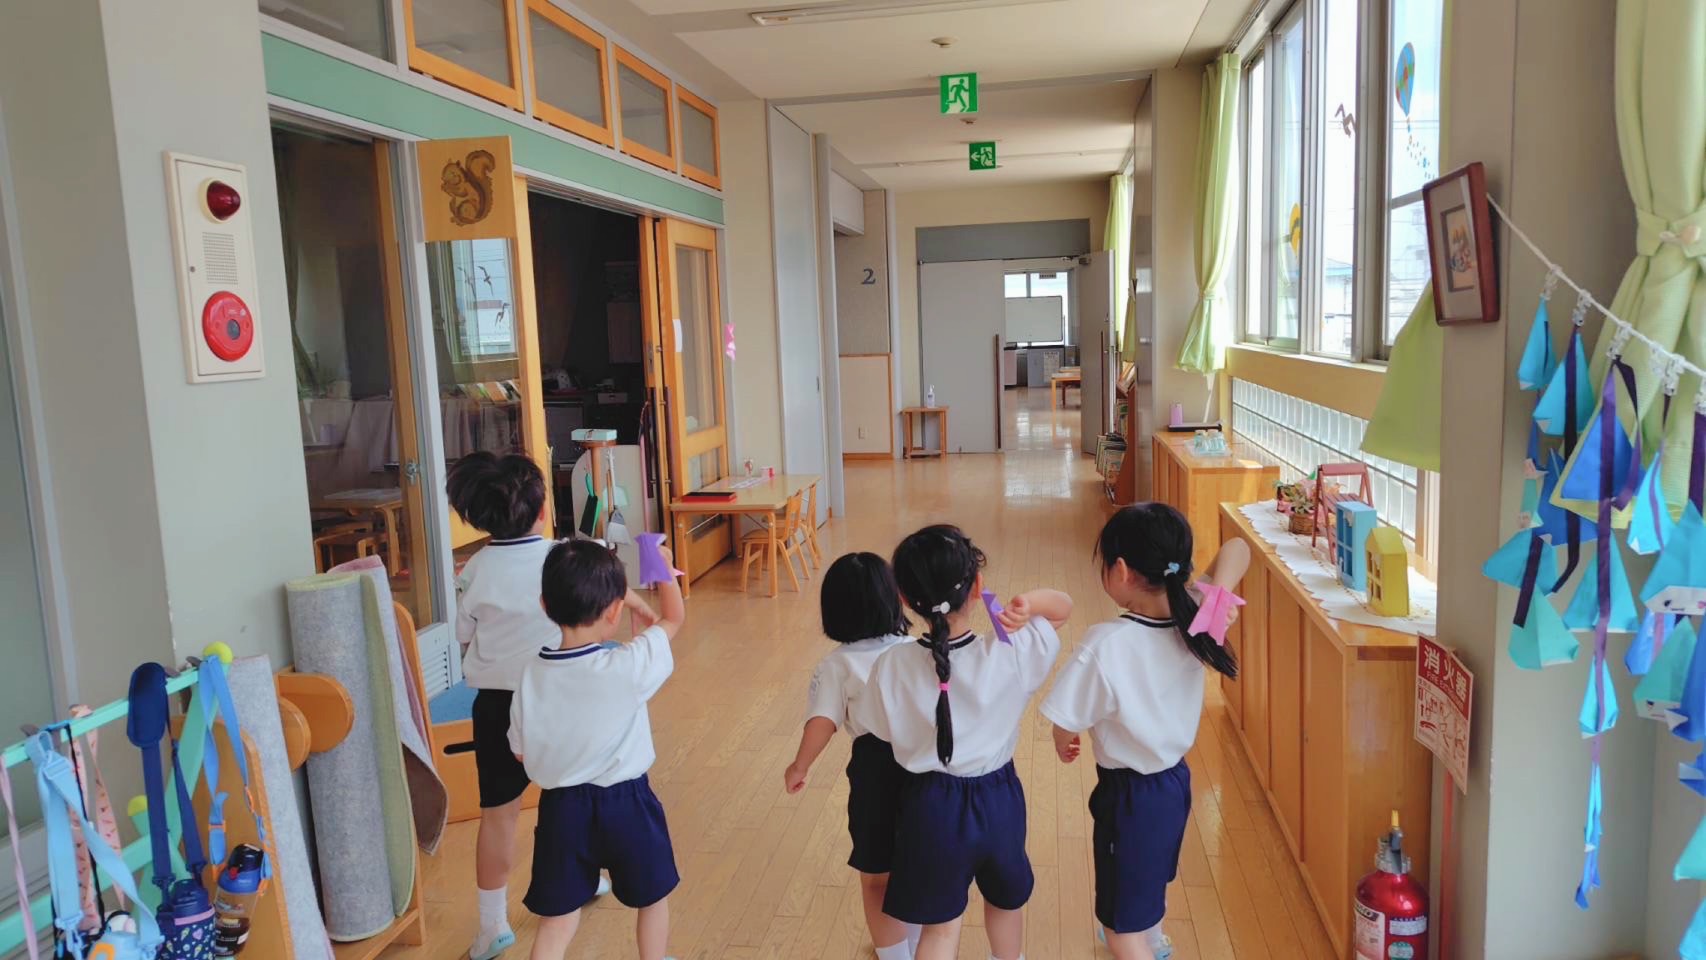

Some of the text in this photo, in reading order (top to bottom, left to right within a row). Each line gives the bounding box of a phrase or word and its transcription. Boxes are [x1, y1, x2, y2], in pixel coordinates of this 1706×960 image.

[861, 268, 876, 285] 2
[1424, 644, 1467, 702] 消火器
